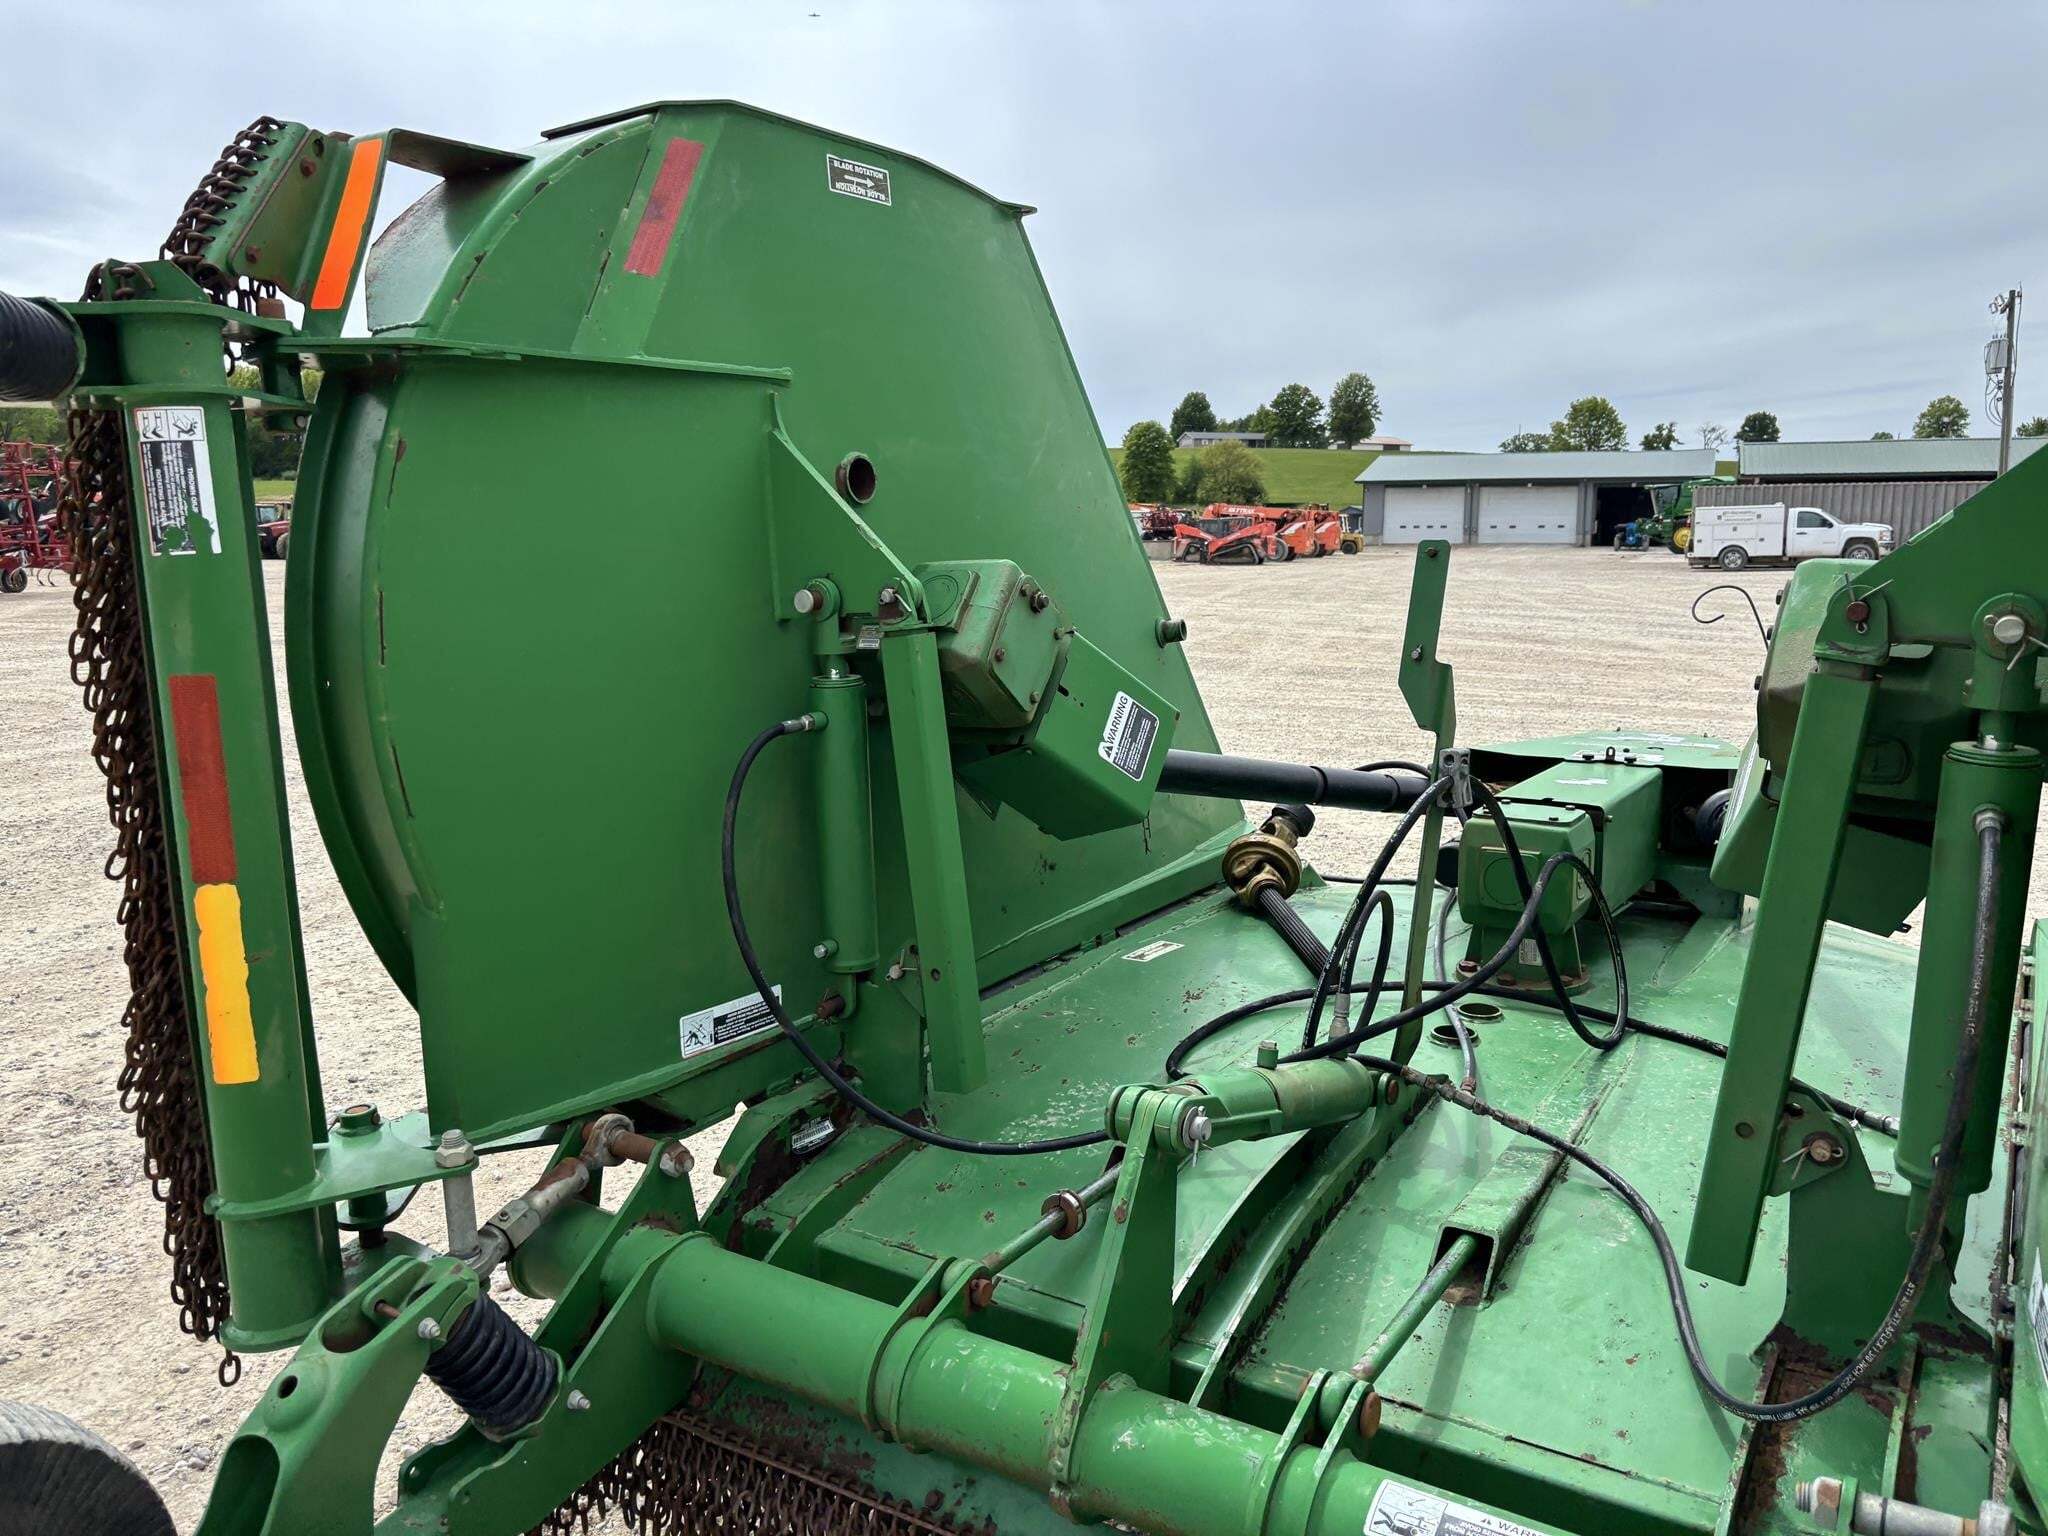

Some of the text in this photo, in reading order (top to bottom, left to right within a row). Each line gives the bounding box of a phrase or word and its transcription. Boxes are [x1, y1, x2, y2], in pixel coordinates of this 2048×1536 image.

[833, 160, 884, 180] BLADE ROTATION
[187, 467, 197, 496] THROWN
[1106, 695, 1128, 745] WARNING
